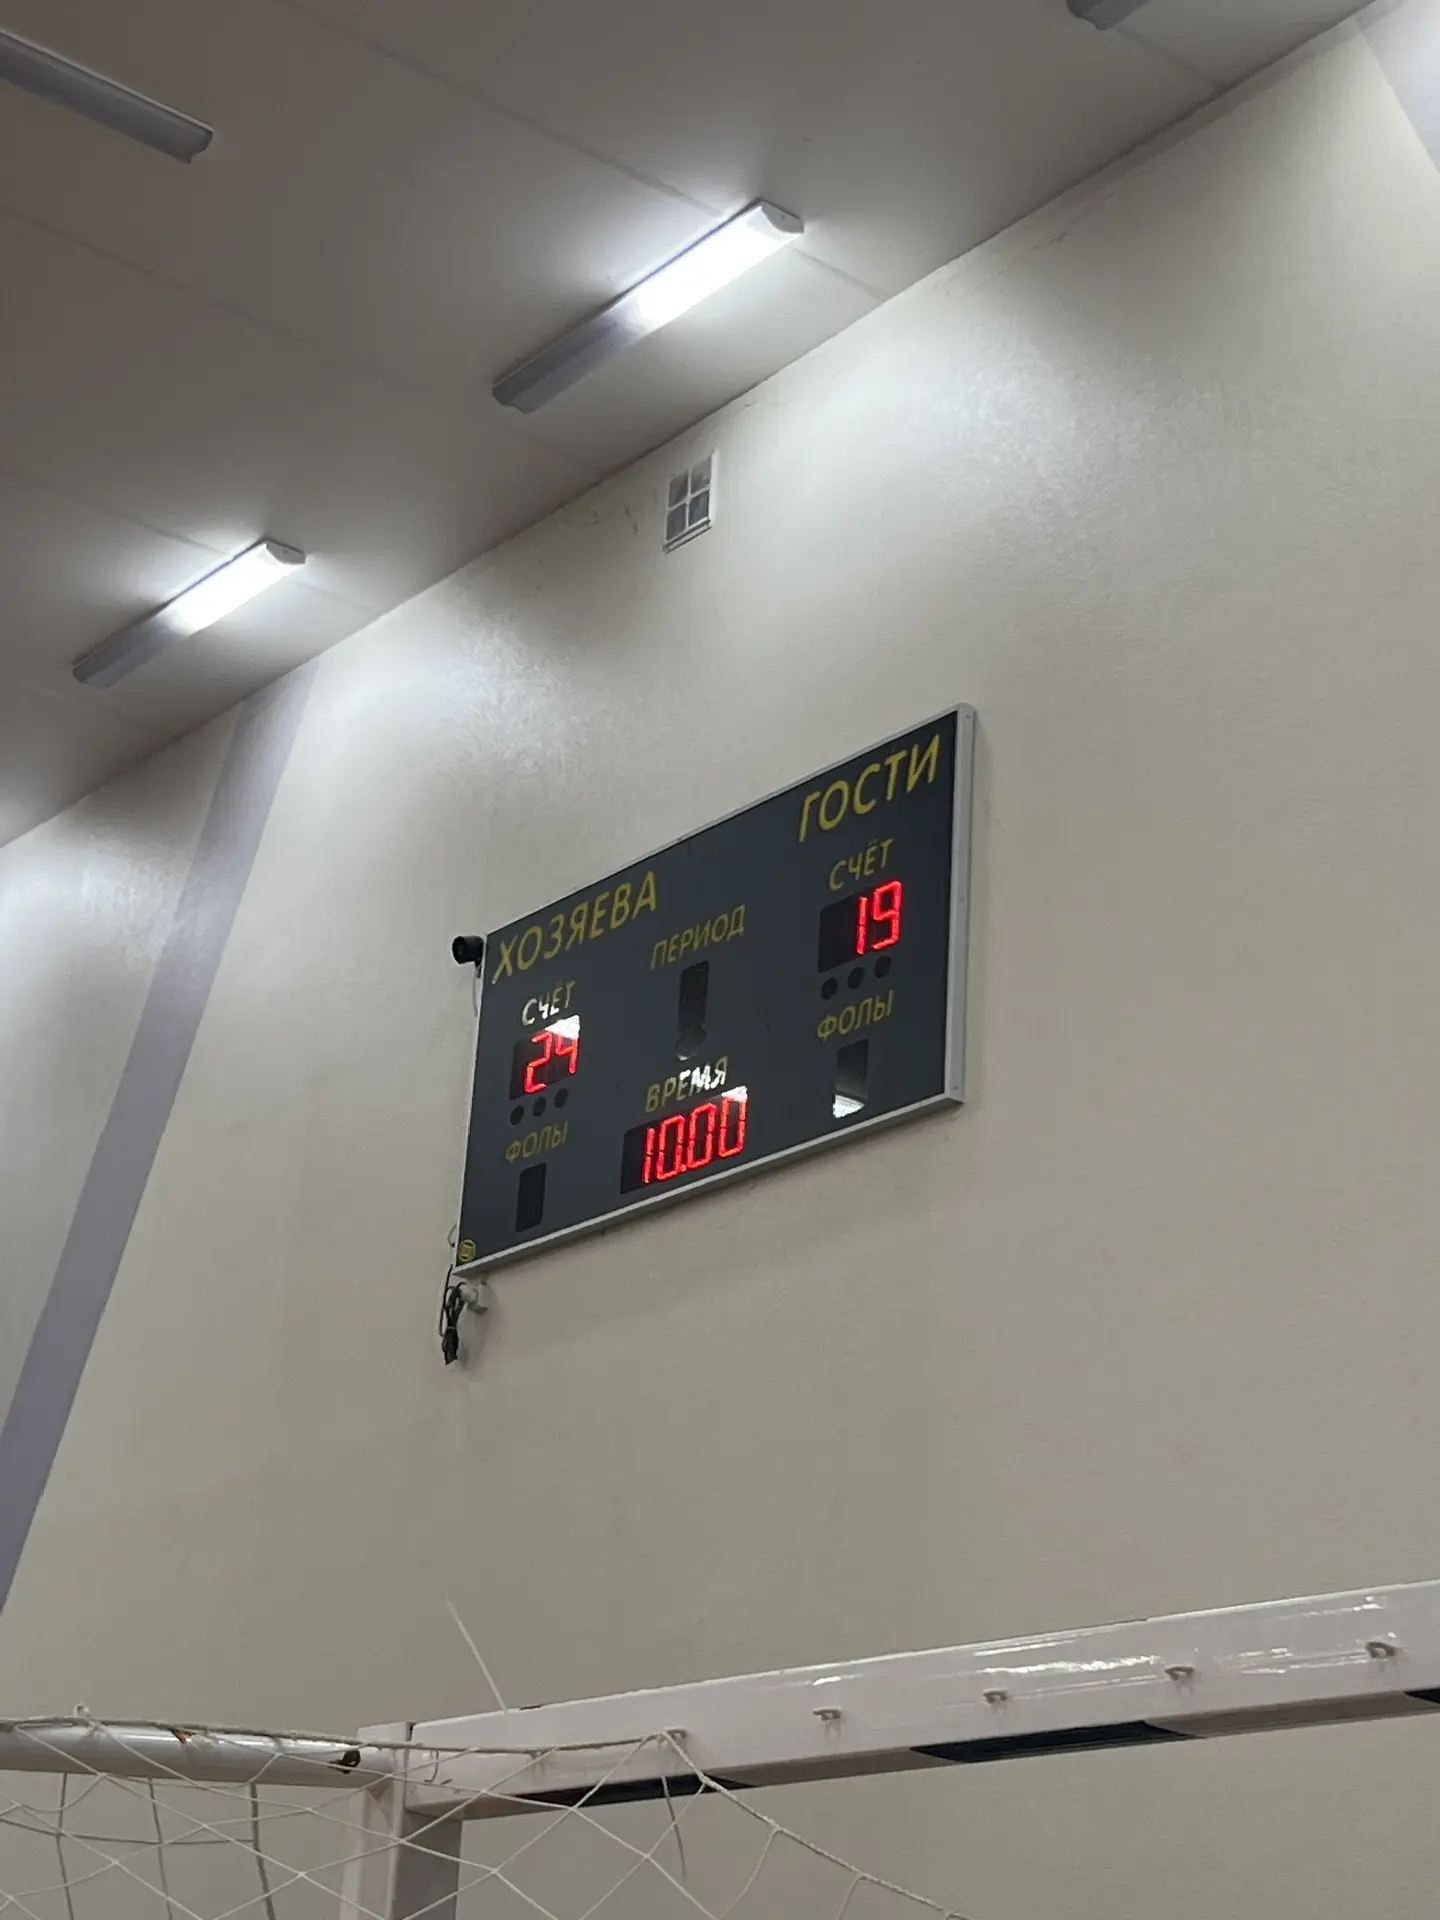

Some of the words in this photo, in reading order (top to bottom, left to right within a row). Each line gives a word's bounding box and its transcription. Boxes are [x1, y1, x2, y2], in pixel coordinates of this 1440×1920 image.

[799, 734, 940, 843] ГОСТИ
[491, 870, 657, 984] ХОЗЯЕВА
[650, 904, 746, 971] ПЕРИОД
[856, 880, 902, 955] 19
[817, 988, 894, 1041] ФОЛЫ
[524, 1029, 579, 1094] 24
[645, 1056, 728, 1113] ВРЕМЯ
[505, 1120, 568, 1162] ФОЛЫ
